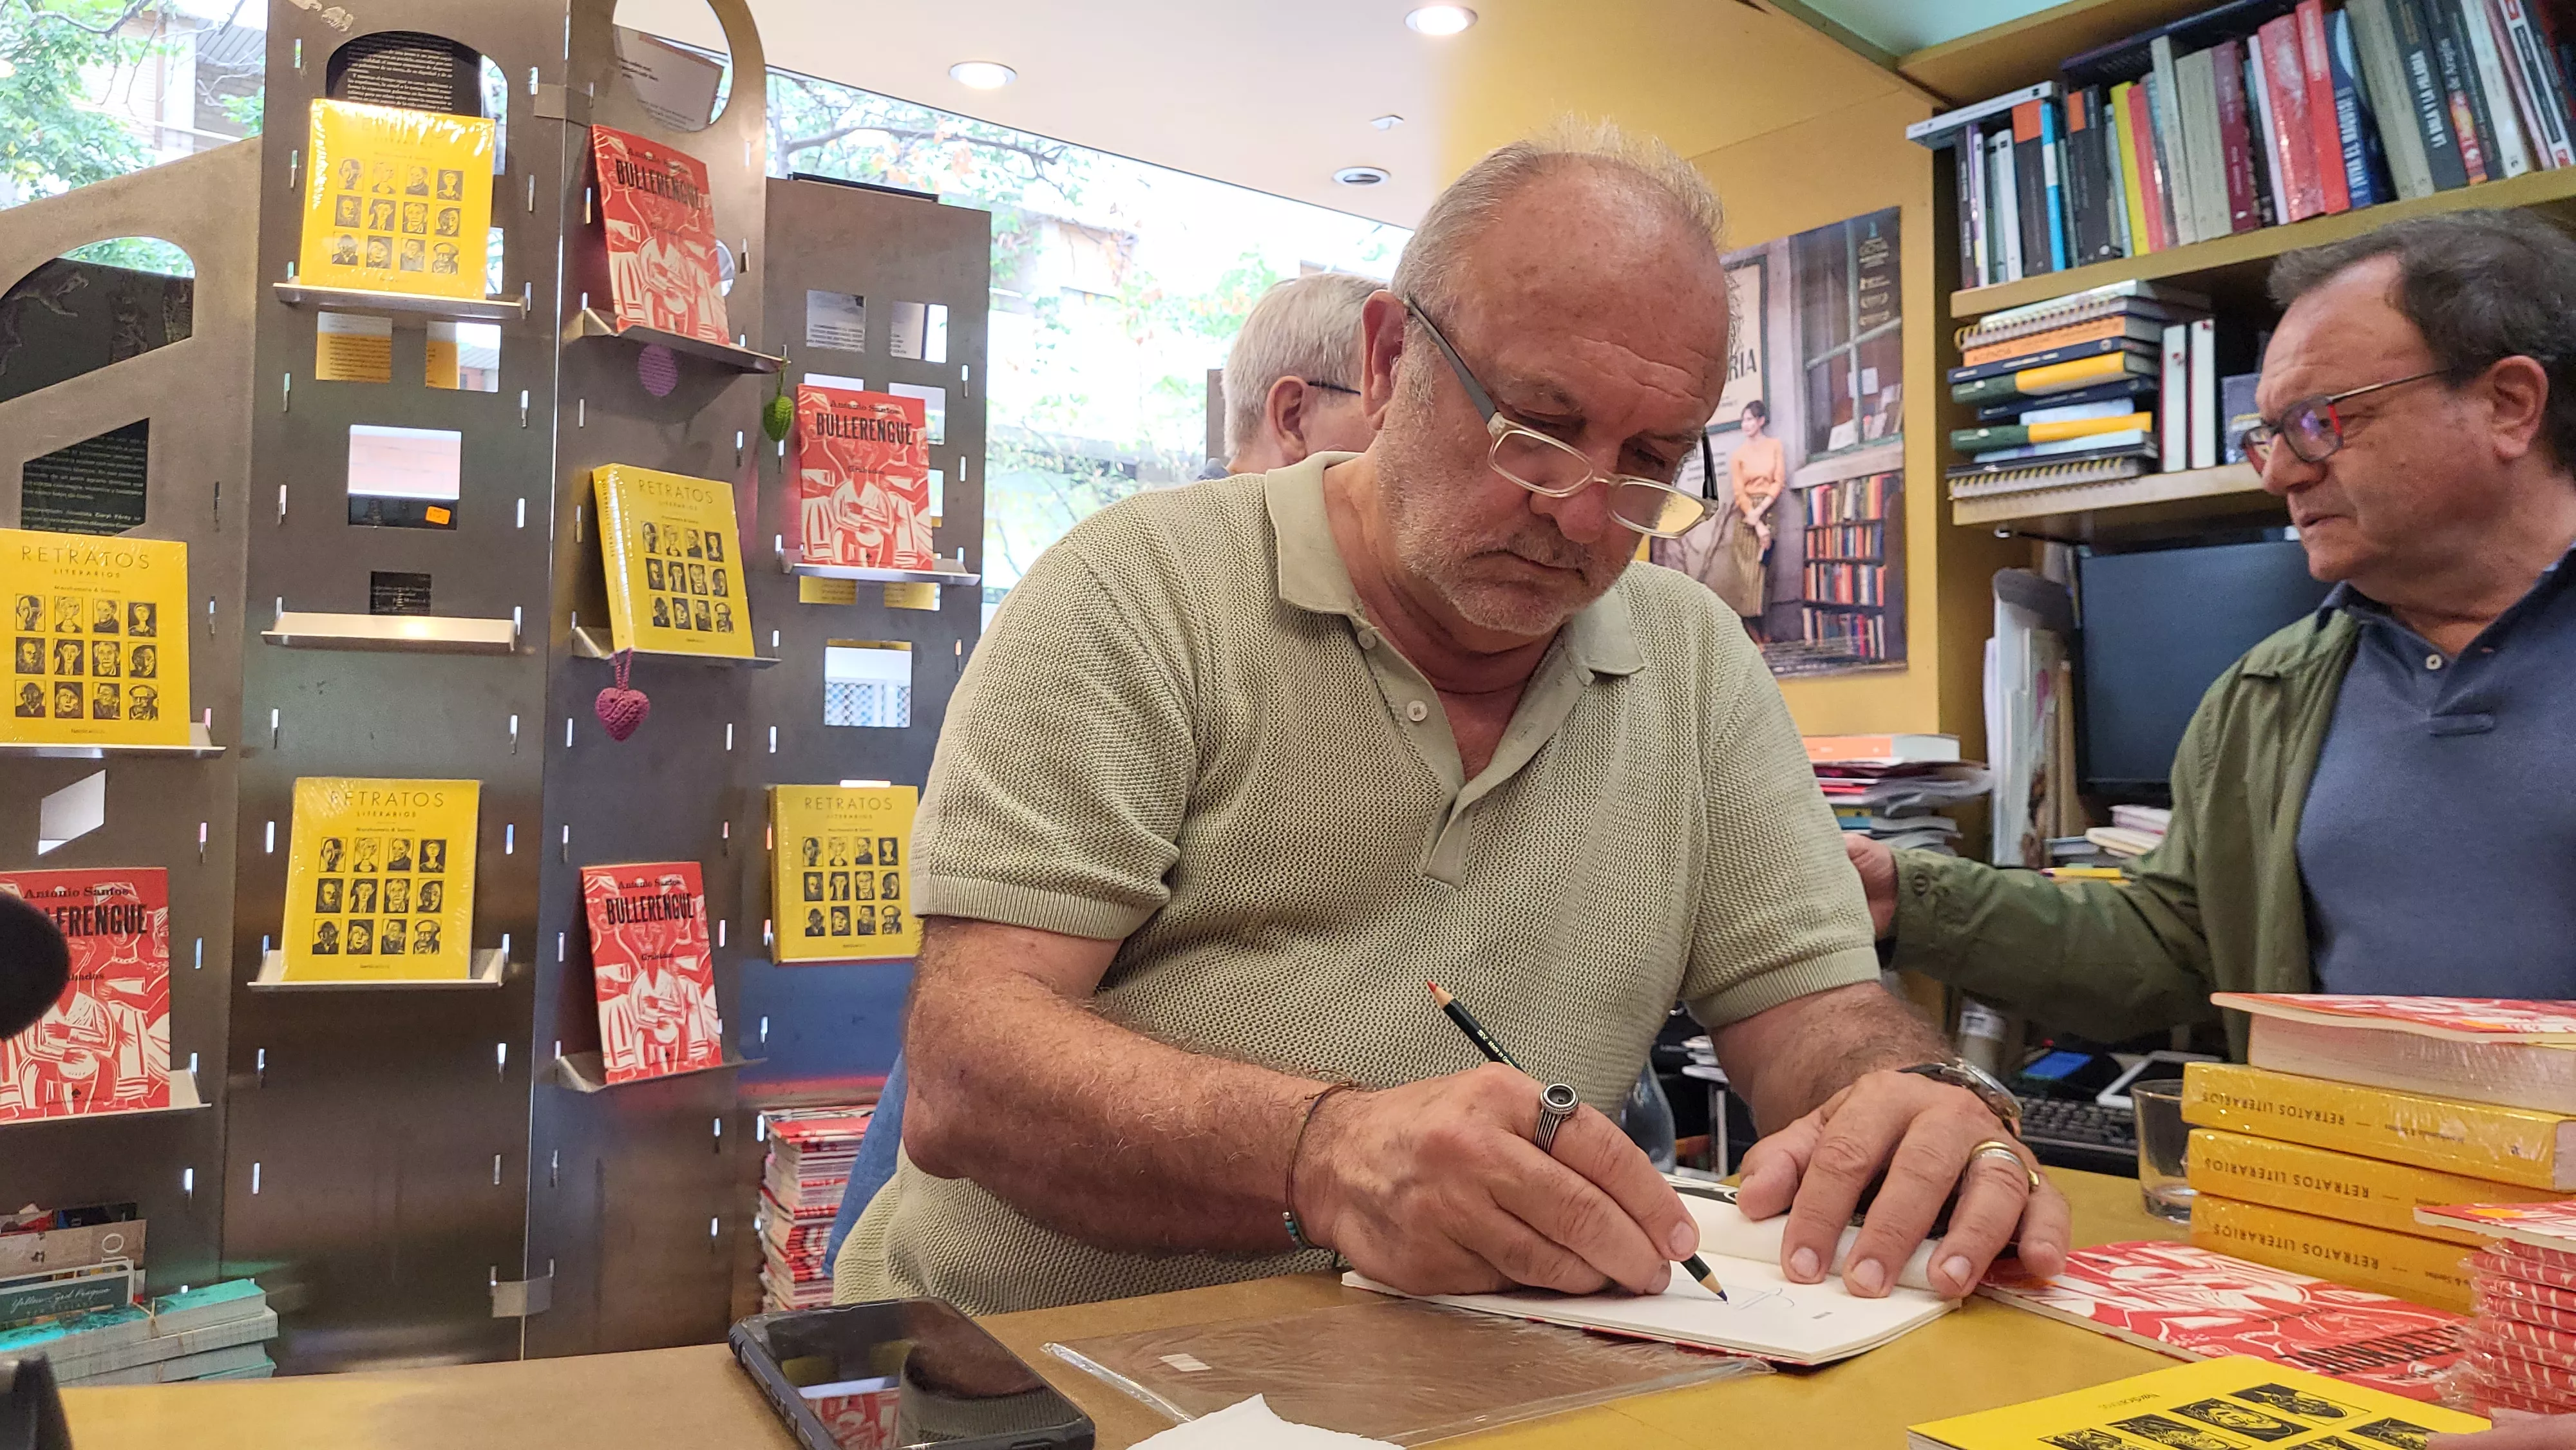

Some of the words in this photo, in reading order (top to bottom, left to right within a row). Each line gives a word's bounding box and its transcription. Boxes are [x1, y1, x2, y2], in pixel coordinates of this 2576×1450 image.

[1728, 348, 1757, 382] RIA
[817, 412, 913, 446] BULLERENGUE
[639, 479, 714, 504] RETRATOS
[22, 545, 149, 570] RETRATOS
[54, 569, 120, 579] LITERARIOS
[331, 791, 444, 808] RETRATOS
[805, 797, 893, 810] RETRATOS
[24, 889, 79, 899] Antonio
[84, 887, 129, 897] Santos
[57, 903, 147, 937] ERENGUE
[606, 893, 694, 925] BULLERENGUE
[2202, 1091, 2273, 1114] LITERARIOS
[2278, 1104, 2345, 1126] RETRATOS
[2204, 1158, 2286, 1183] LITERARIOS
[2293, 1174, 2369, 1198] RETRATOS
[2213, 1223, 2295, 1251] LITERARIOS
[2302, 1243, 2379, 1270] RETRATOS
